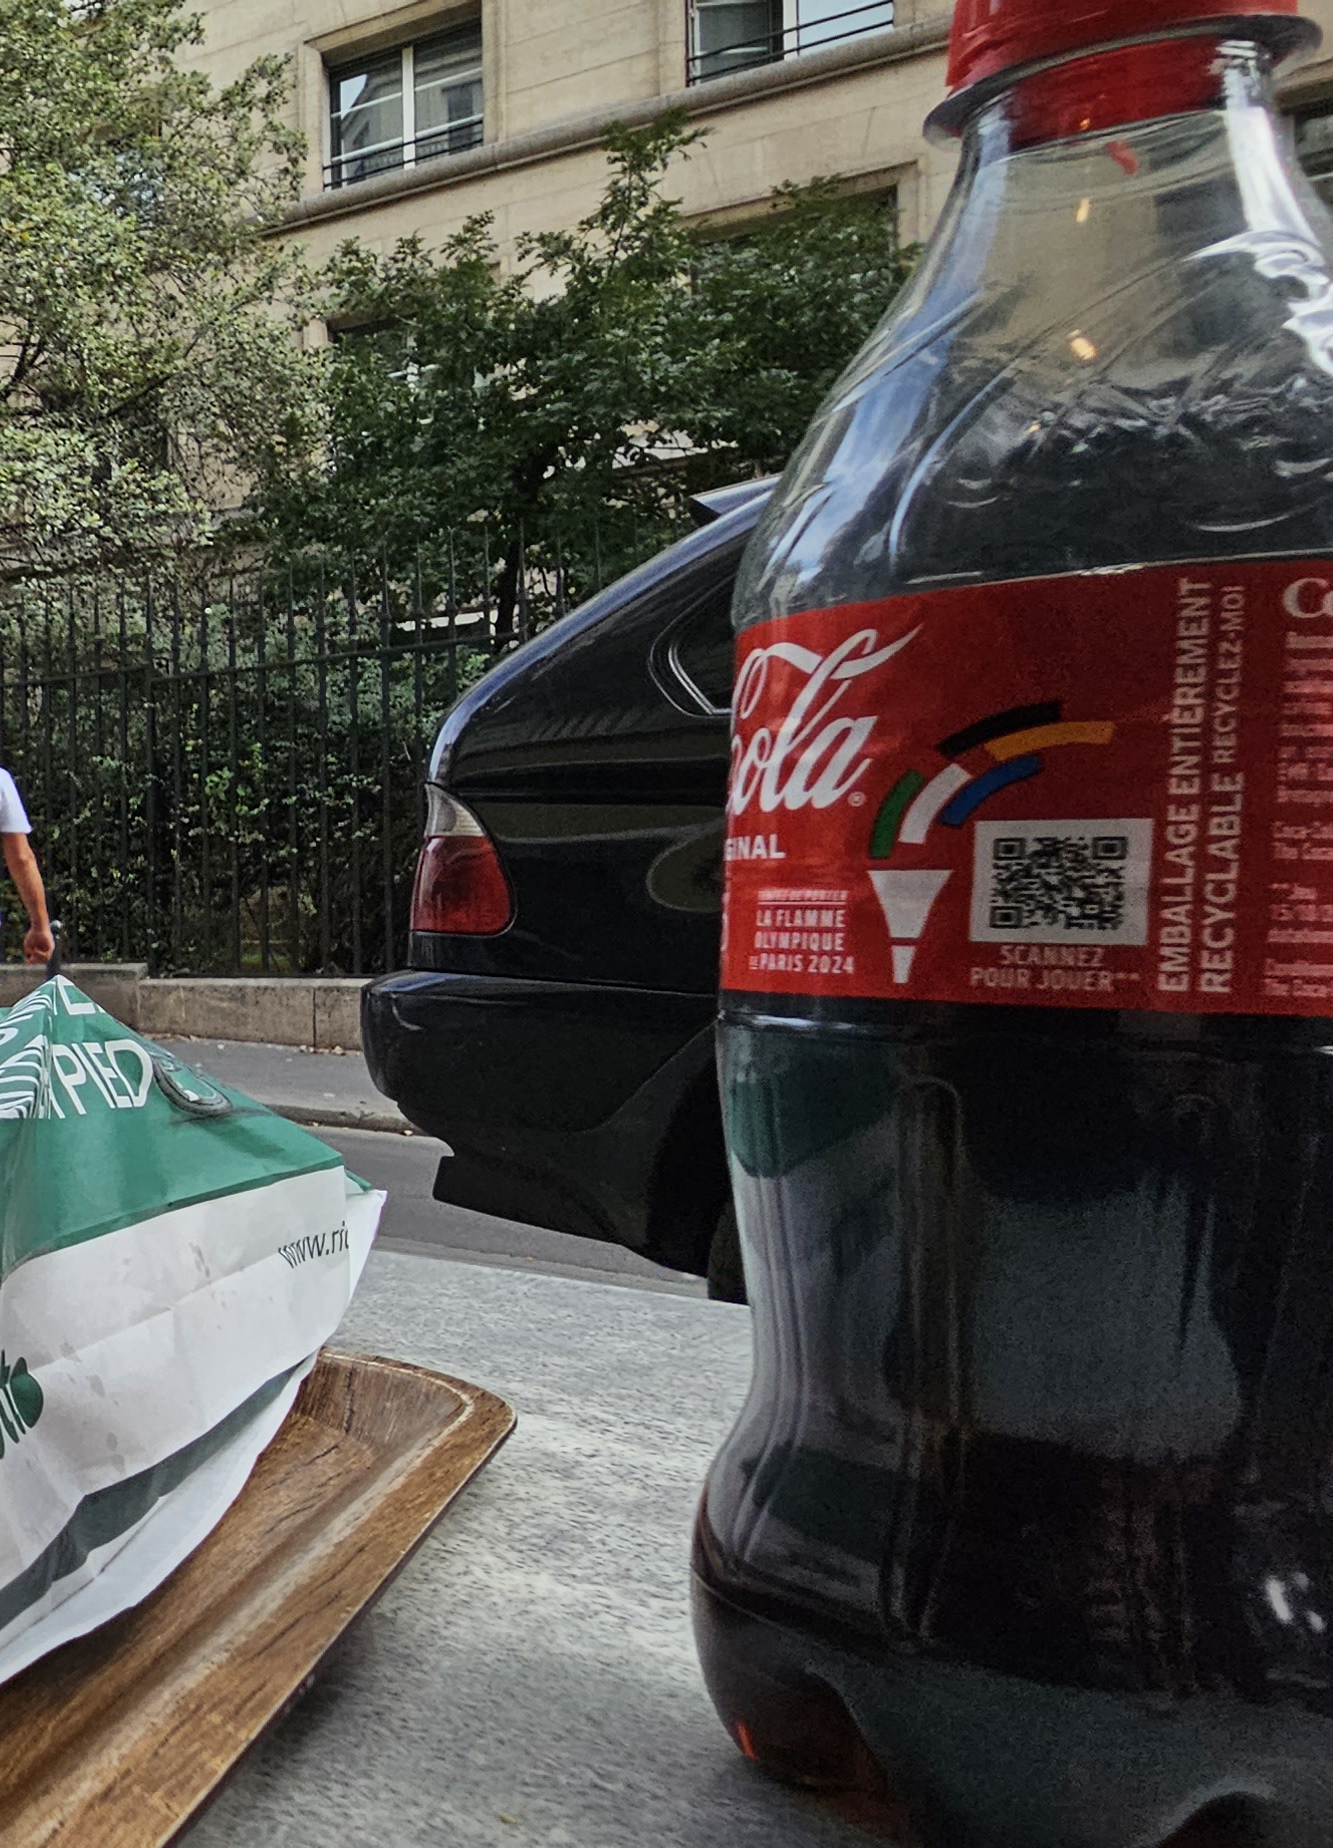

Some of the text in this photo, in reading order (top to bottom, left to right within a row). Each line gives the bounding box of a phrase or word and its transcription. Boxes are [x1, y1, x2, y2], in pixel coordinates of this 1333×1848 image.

[1199, 585, 1247, 993] RECYCLABLE RECYCLEZ-MOI
[1158, 804, 1202, 992] EMBALLAGE
[775, 909, 846, 928] FLAMME
[754, 930, 845, 951] OLYMPIQUE
[808, 955, 854, 974] 2024
[1000, 944, 1104, 967] SCANNEZ
[970, 966, 1031, 989] POUR
